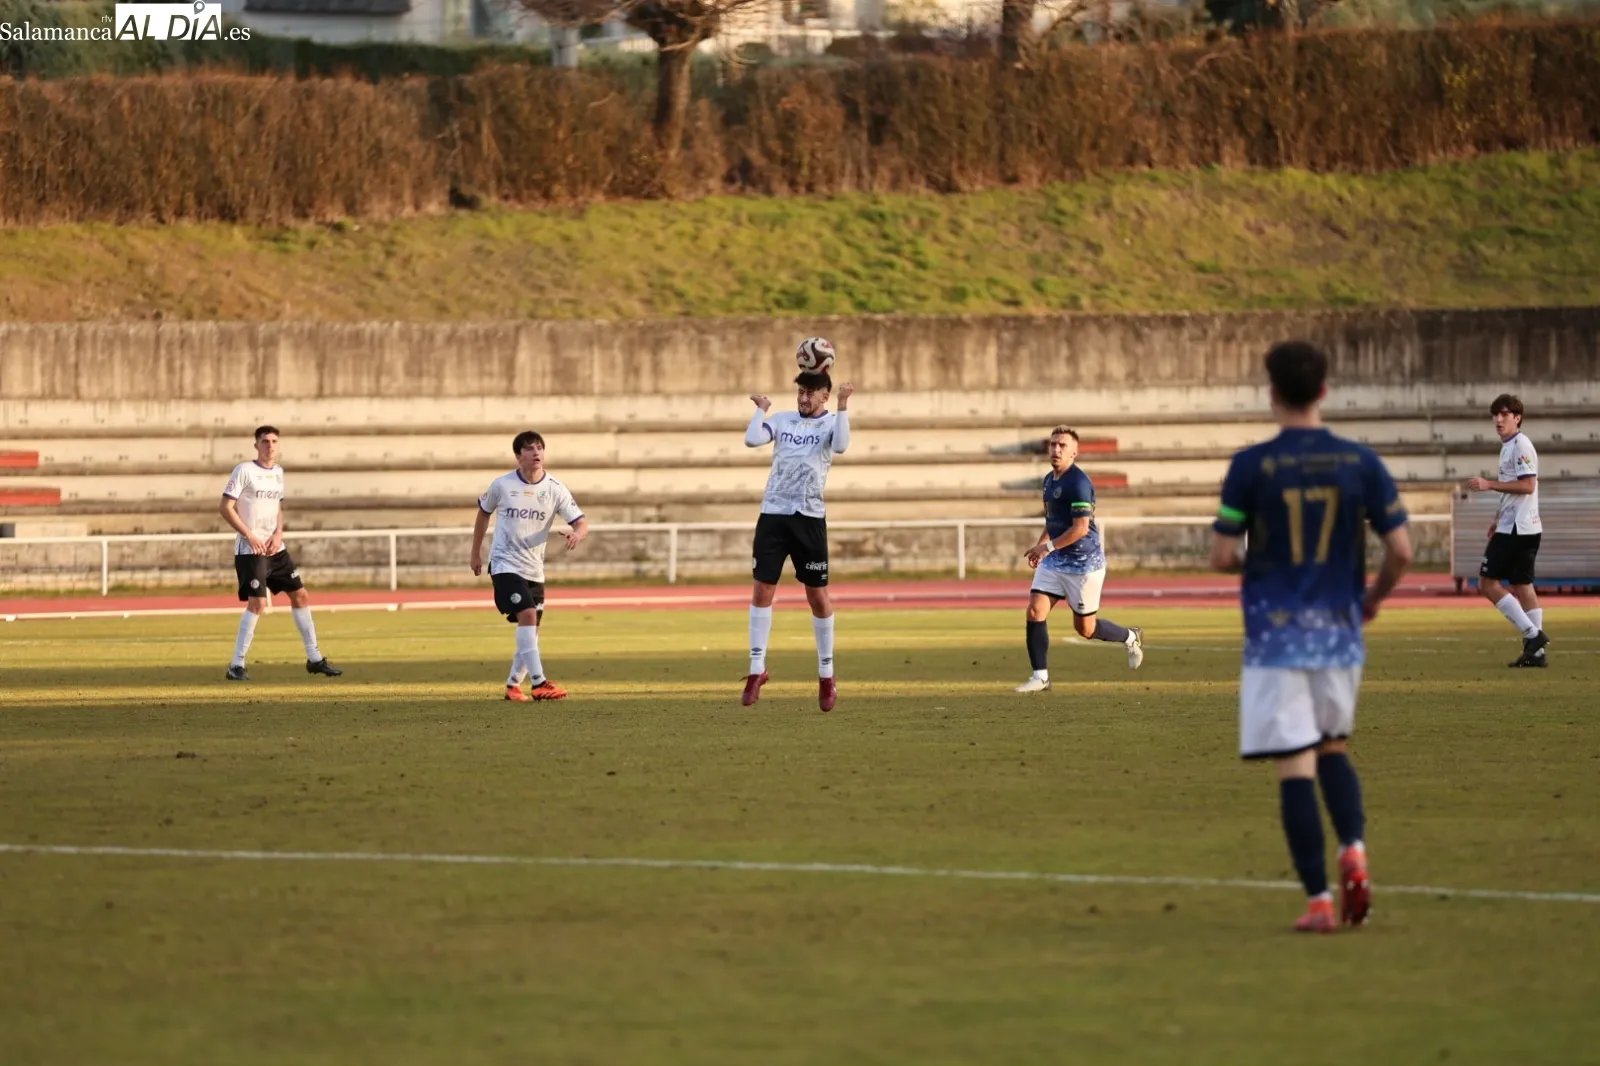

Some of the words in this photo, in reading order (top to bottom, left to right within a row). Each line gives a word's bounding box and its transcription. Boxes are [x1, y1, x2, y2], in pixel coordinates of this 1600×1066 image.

[780, 431, 820, 445] meins
[506, 507, 546, 521] meins
[1282, 486, 1340, 565] 17
